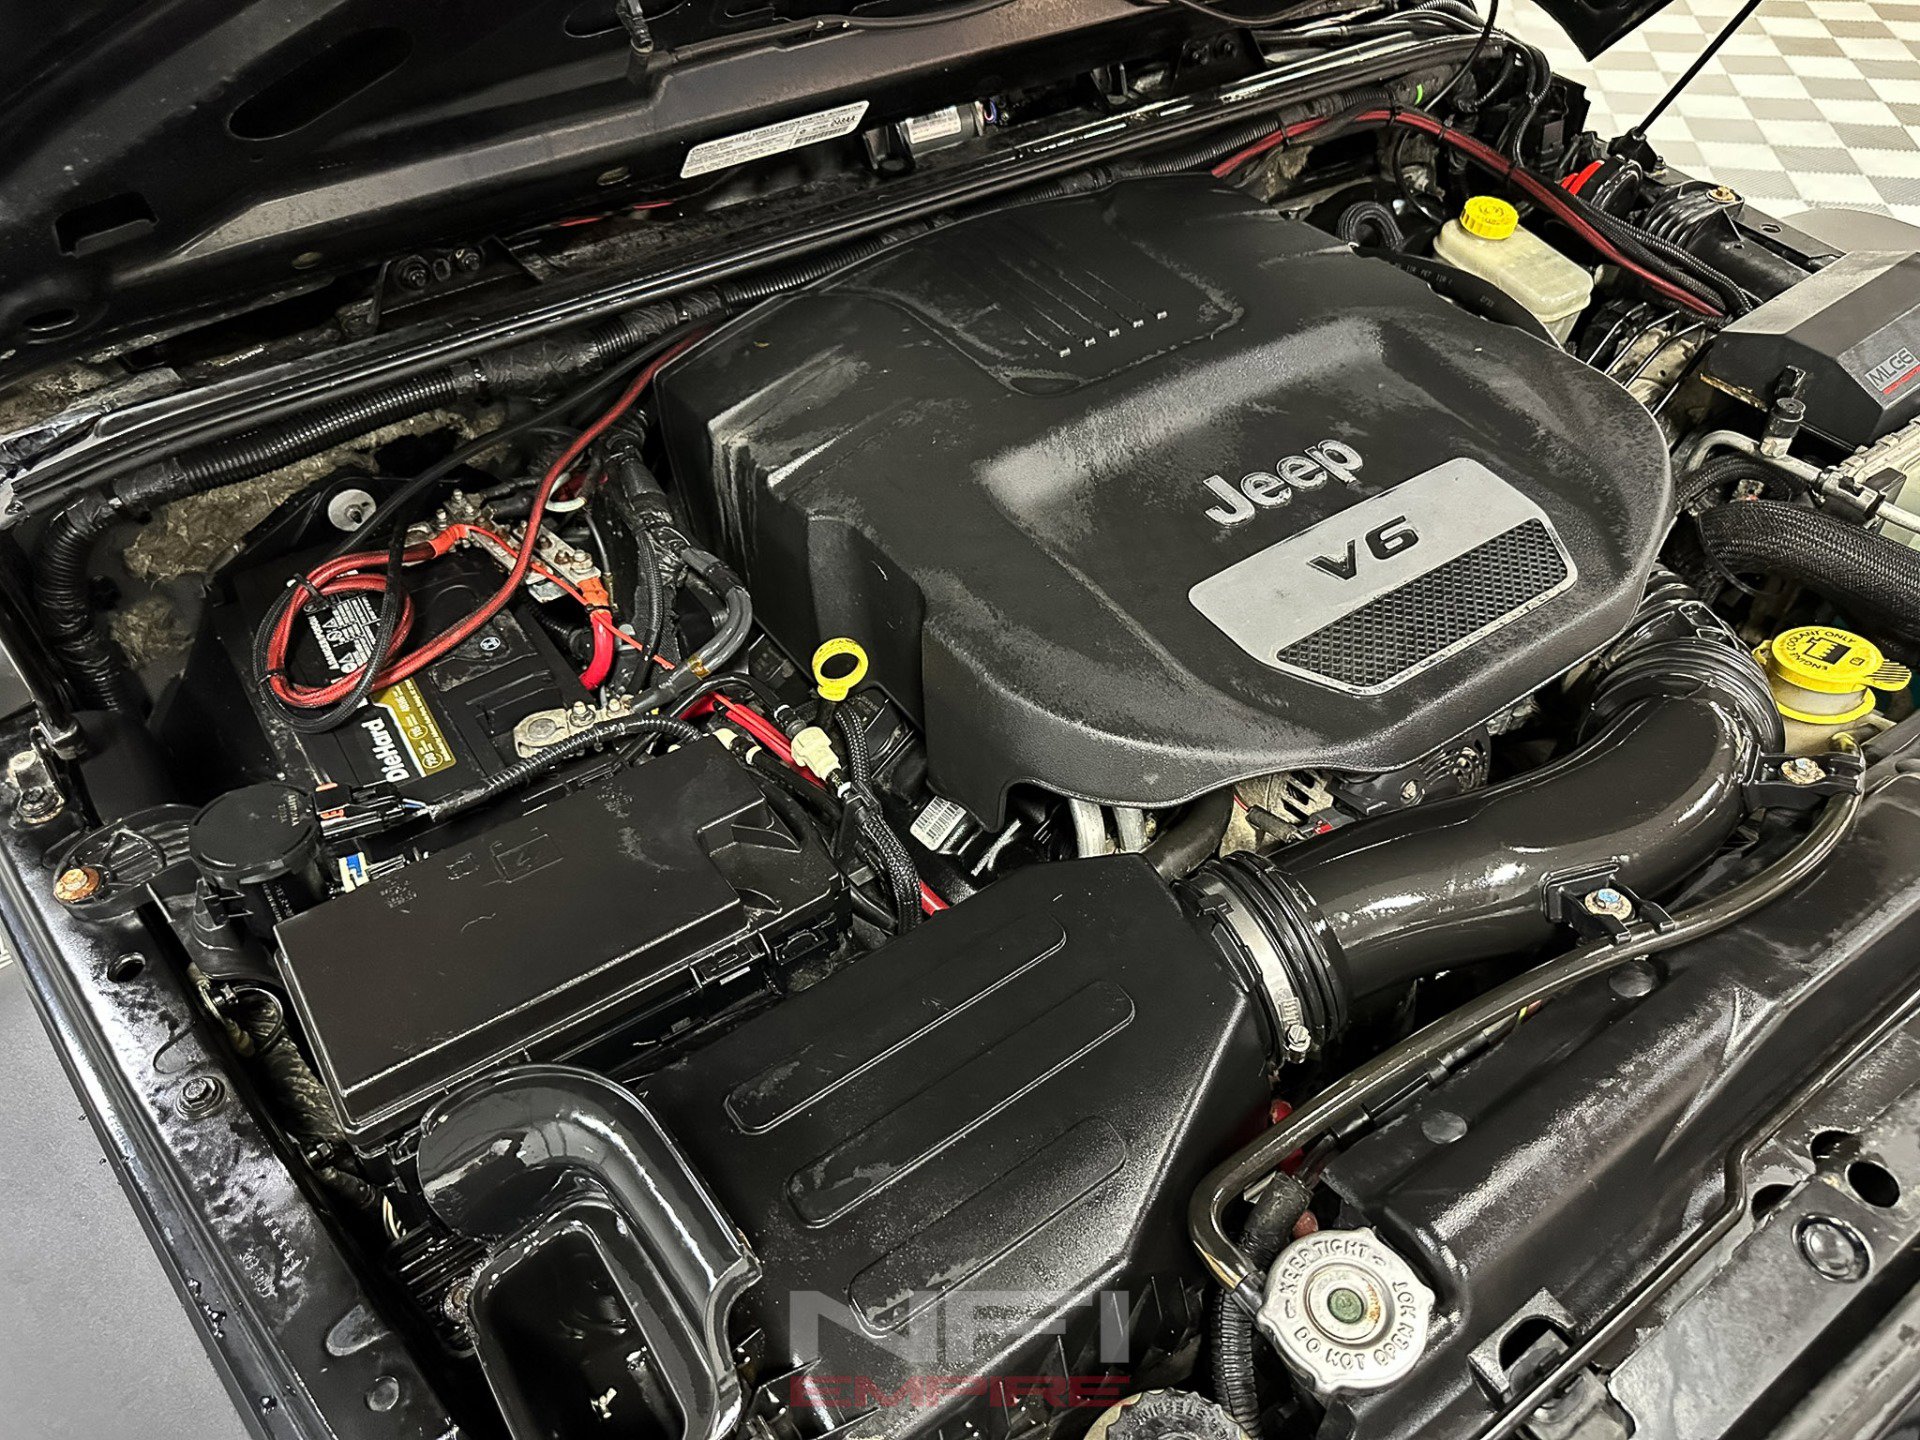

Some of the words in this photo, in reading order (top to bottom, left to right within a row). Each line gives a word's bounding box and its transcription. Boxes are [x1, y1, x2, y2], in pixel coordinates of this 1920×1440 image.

[1202, 438, 1365, 526] Jeep
[1307, 515, 1419, 580] V6
[1786, 630, 1820, 652] COOLANT
[1825, 632, 1857, 643] ONLY
[360, 717, 411, 784] DieHard
[1278, 1247, 1311, 1296] KEEP
[1313, 1239, 1372, 1258] TIGHT
[1392, 1280, 1417, 1320] HOT
[1293, 1325, 1320, 1354] DO
[1326, 1347, 1366, 1370] NOT
[1373, 1322, 1414, 1367] OPEN
